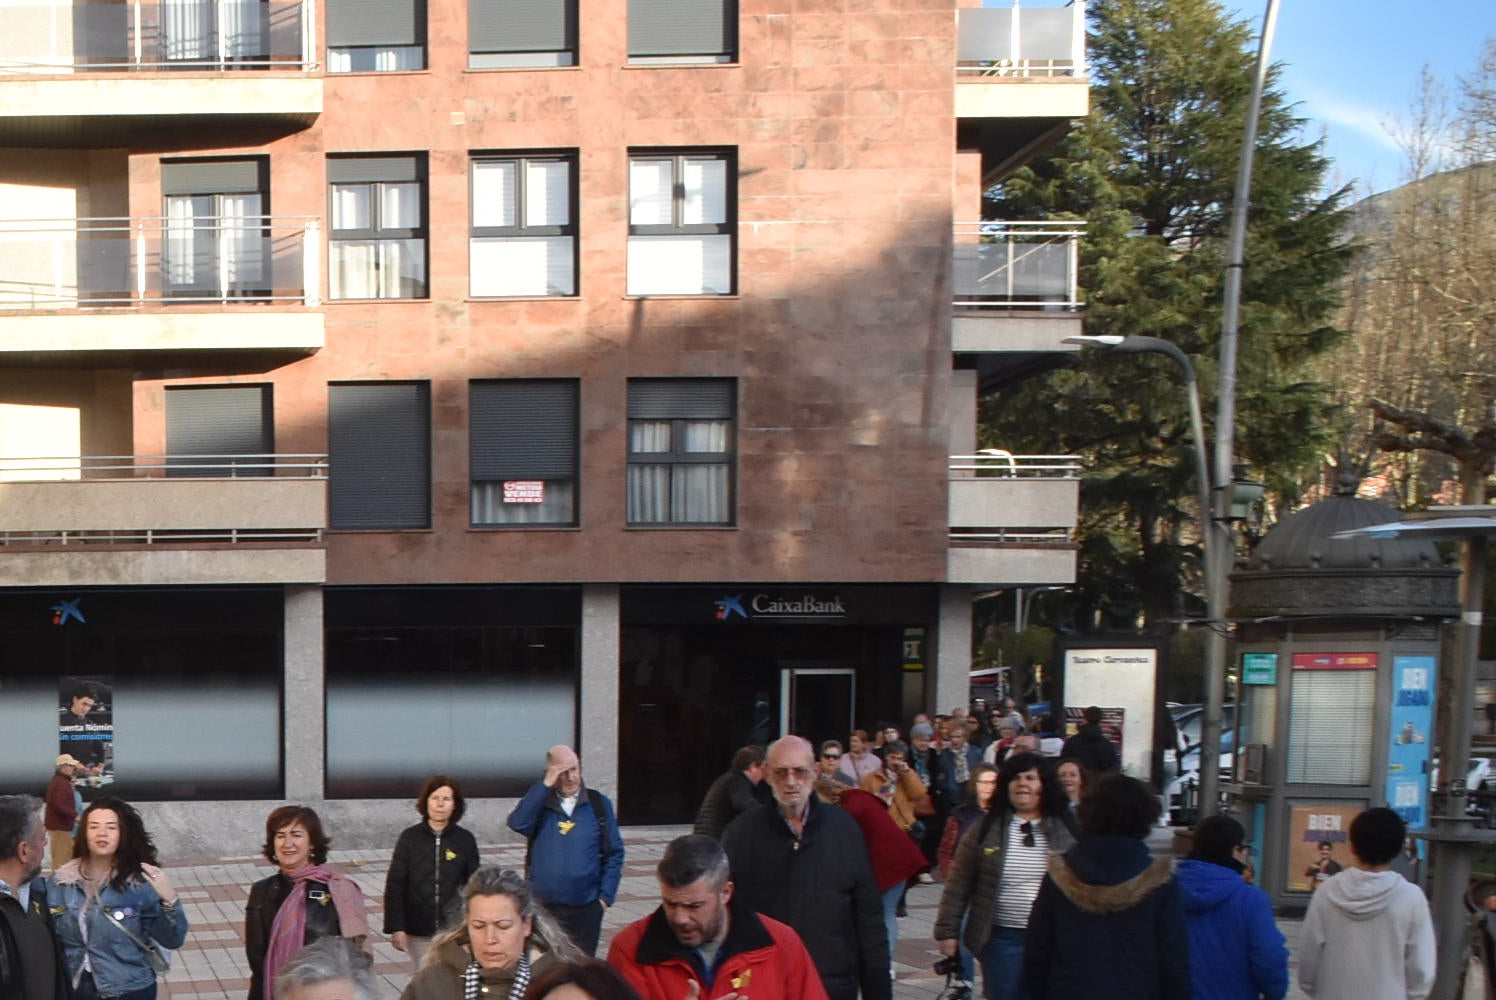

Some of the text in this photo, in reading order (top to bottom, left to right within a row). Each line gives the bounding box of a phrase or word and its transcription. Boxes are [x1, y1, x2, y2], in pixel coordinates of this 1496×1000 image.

[504, 490, 543, 498] VENDE
[752, 593, 846, 613] CaixaBank
[1401, 668, 1427, 689] BIEN
[1308, 814, 1342, 831] BIEN
